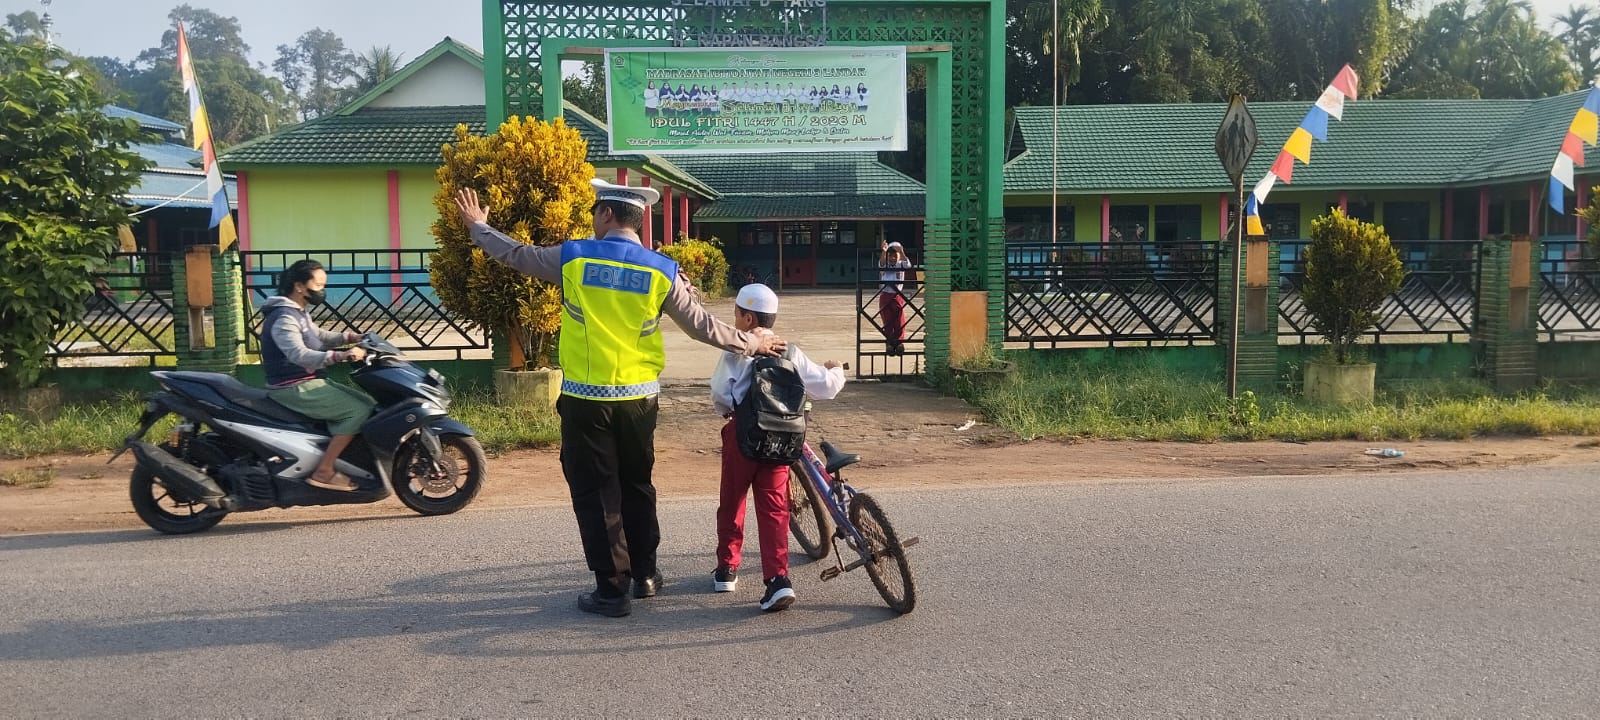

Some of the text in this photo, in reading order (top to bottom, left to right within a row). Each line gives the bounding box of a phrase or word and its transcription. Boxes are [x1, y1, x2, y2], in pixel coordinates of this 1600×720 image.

[647, 68, 707, 79] MADRASAH
[772, 67, 812, 78] NEGERI
[822, 67, 867, 78] LANDAK
[650, 114, 867, 128] IDUL FITRI 1447 H / 2026 M
[586, 265, 650, 291] POLISI
